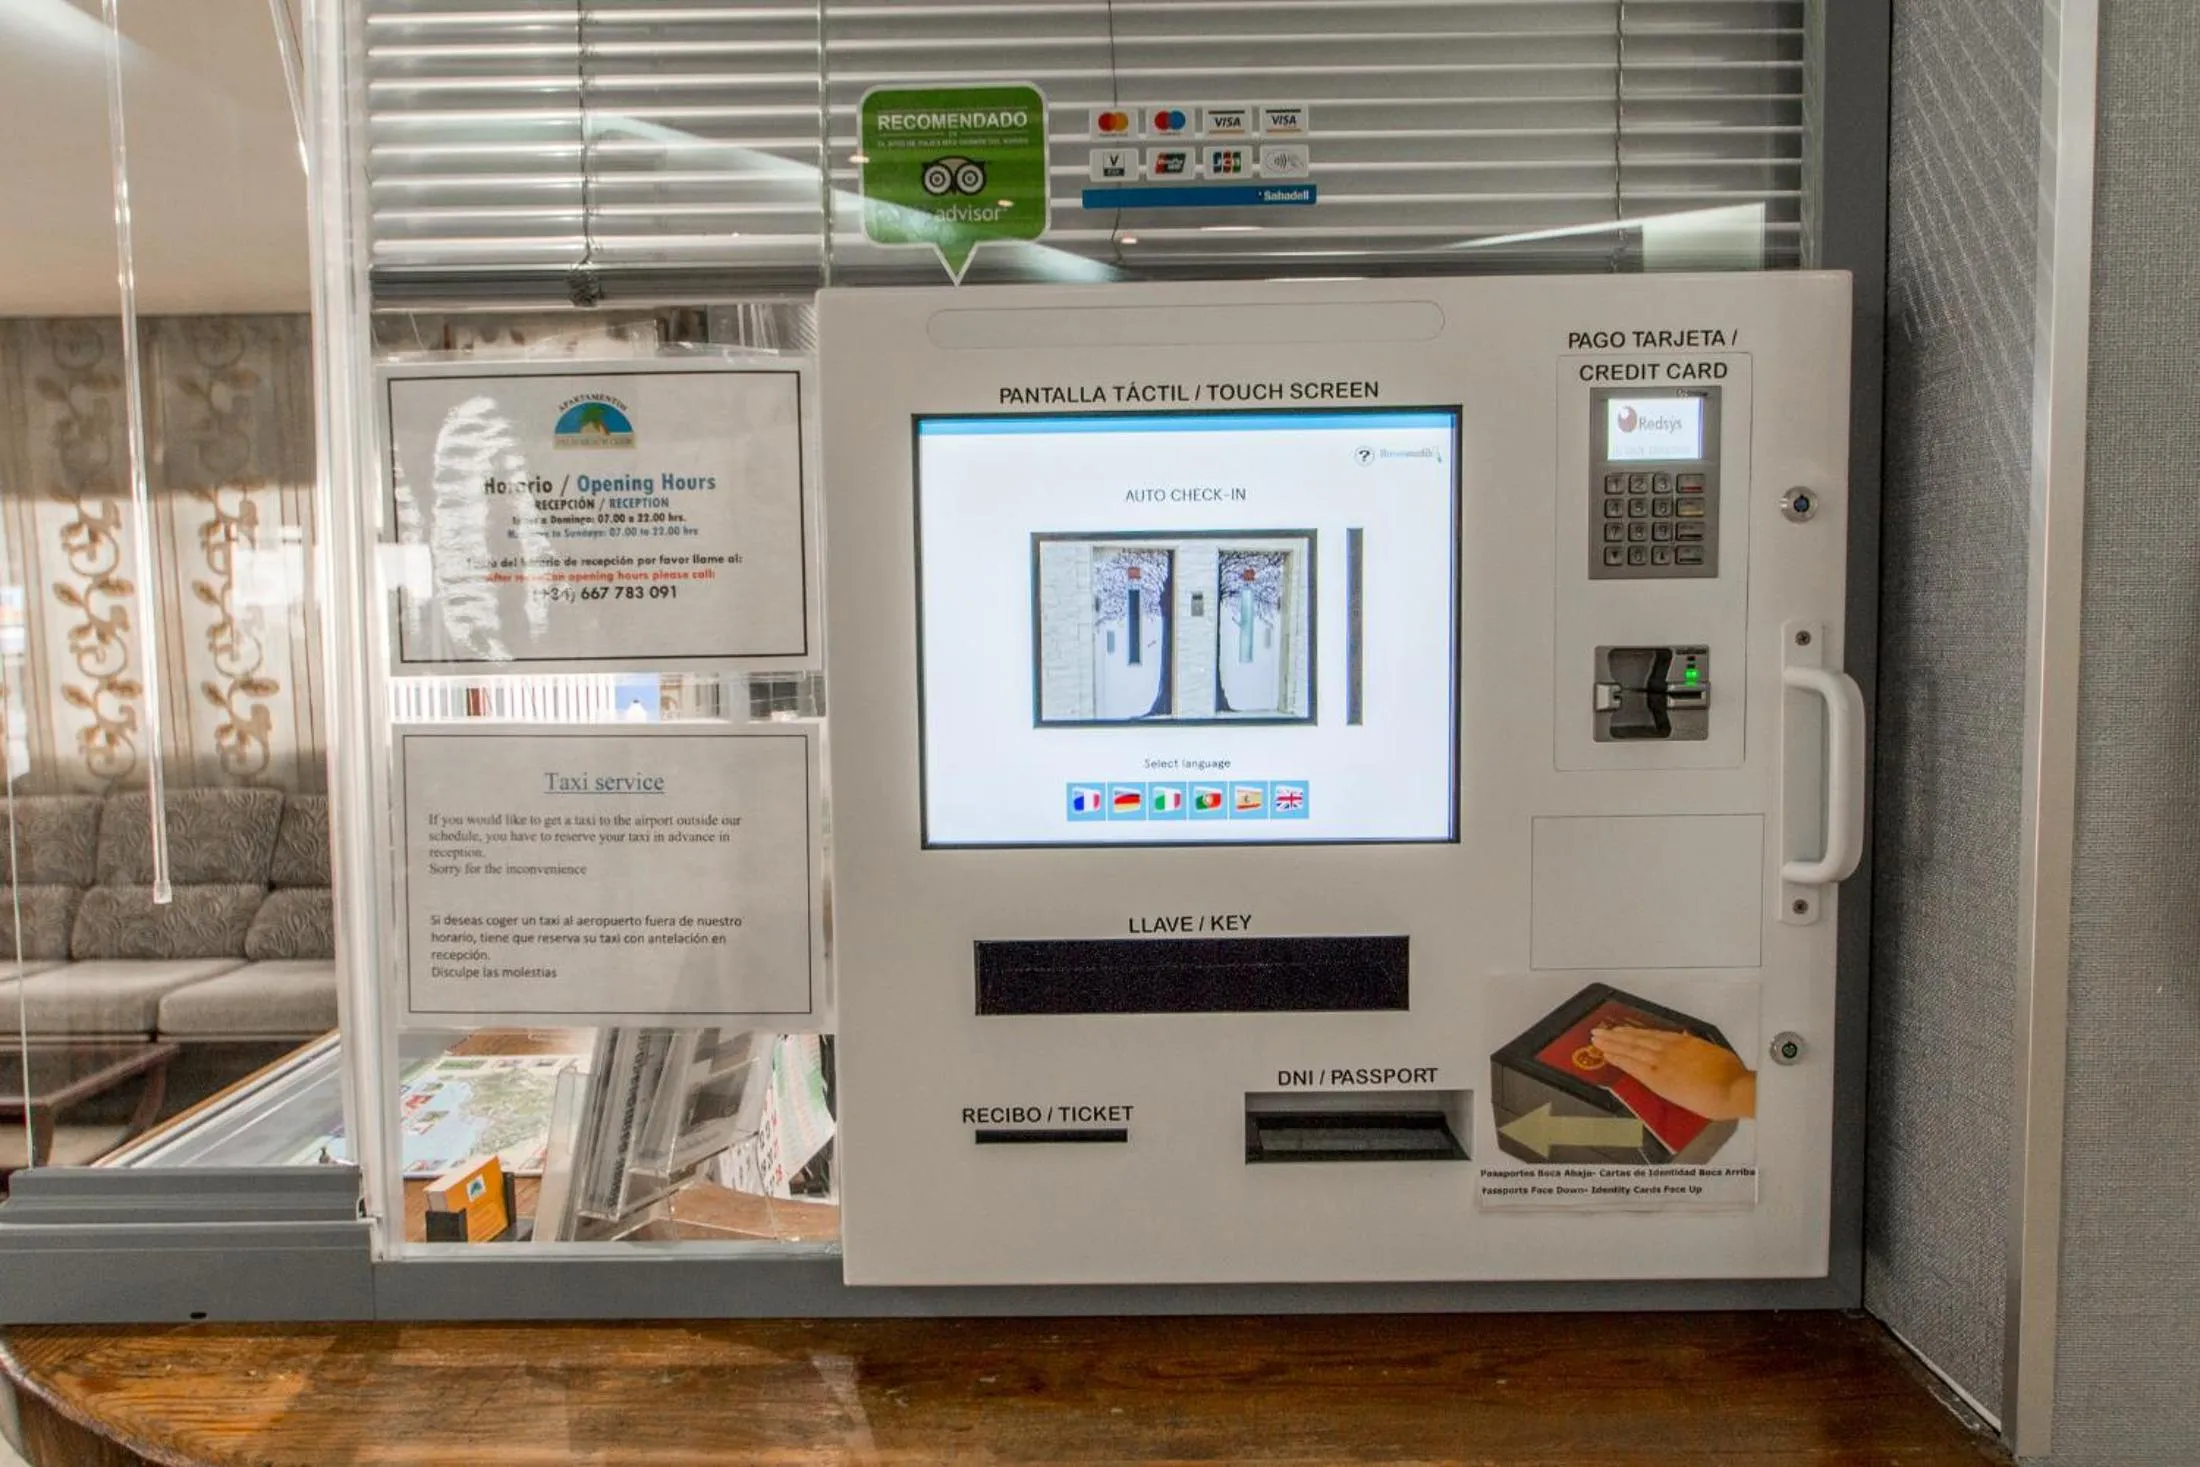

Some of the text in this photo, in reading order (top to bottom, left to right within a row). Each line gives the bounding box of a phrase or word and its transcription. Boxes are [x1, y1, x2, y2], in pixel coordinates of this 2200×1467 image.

[877, 111, 1028, 131] RECOMENDADO
[1214, 116, 1242, 129] VISA
[1272, 114, 1297, 126] VISA
[1263, 189, 1309, 201] Sabadell
[1568, 329, 1738, 349] PAGO TARJETA /
[1580, 362, 1728, 381] CREDIT CARD
[1000, 381, 1379, 404] PANTALLA TÁCTIL / TOUCH SCREEN
[1639, 416, 1682, 434] Redsys
[560, 475, 570, 496] /
[577, 474, 654, 496] Opening
[661, 473, 716, 490] Hours
[1125, 488, 1246, 501] AUTO CHECK-IN
[535, 496, 596, 511] RECEPCIÓN
[609, 498, 669, 508] RECEPTION
[597, 513, 626, 524] 07.00
[637, 513, 665, 522] 22.00
[581, 554, 634, 568] recepción
[637, 555, 656, 567] por
[659, 553, 690, 565] favor
[692, 552, 725, 564] llame
[569, 570, 614, 583] opening
[618, 569, 649, 580] hours
[652, 567, 689, 581] please
[691, 566, 716, 579] call:
[581, 586, 609, 599] 667
[614, 586, 645, 599] 783
[649, 585, 677, 598] 091
[1144, 758, 1232, 770] Select language
[545, 772, 665, 791] Taxi service
[429, 814, 741, 829] If you would like to get a taxi to the airport outside our
[429, 830, 730, 845] schedule, you have to reserve your taxi in advance in
[429, 848, 486, 861] reception.
[429, 863, 587, 878] Sorry for the inconvenience
[431, 914, 742, 929] Si deseas coger un taxi al aeropuerto fuera de nuestro
[1129, 915, 1252, 933] LLAVE / KEY
[431, 932, 726, 947] horario, tiene que reserva su taxi con antelación en
[431, 948, 490, 963] recepción.
[431, 966, 557, 981] Disculpe las molestias
[1278, 1067, 1439, 1085] DNI / PASSPORT
[962, 1105, 1134, 1123] RECIBO / TICKET
[1599, 1168, 1631, 1177] Cartas
[1649, 1168, 1696, 1176] Identidad
[1482, 1186, 1528, 1196] Passports
[1531, 1186, 1554, 1194] Face
[1591, 1185, 1630, 1196] Identity
[1688, 1184, 1702, 1195] Up
